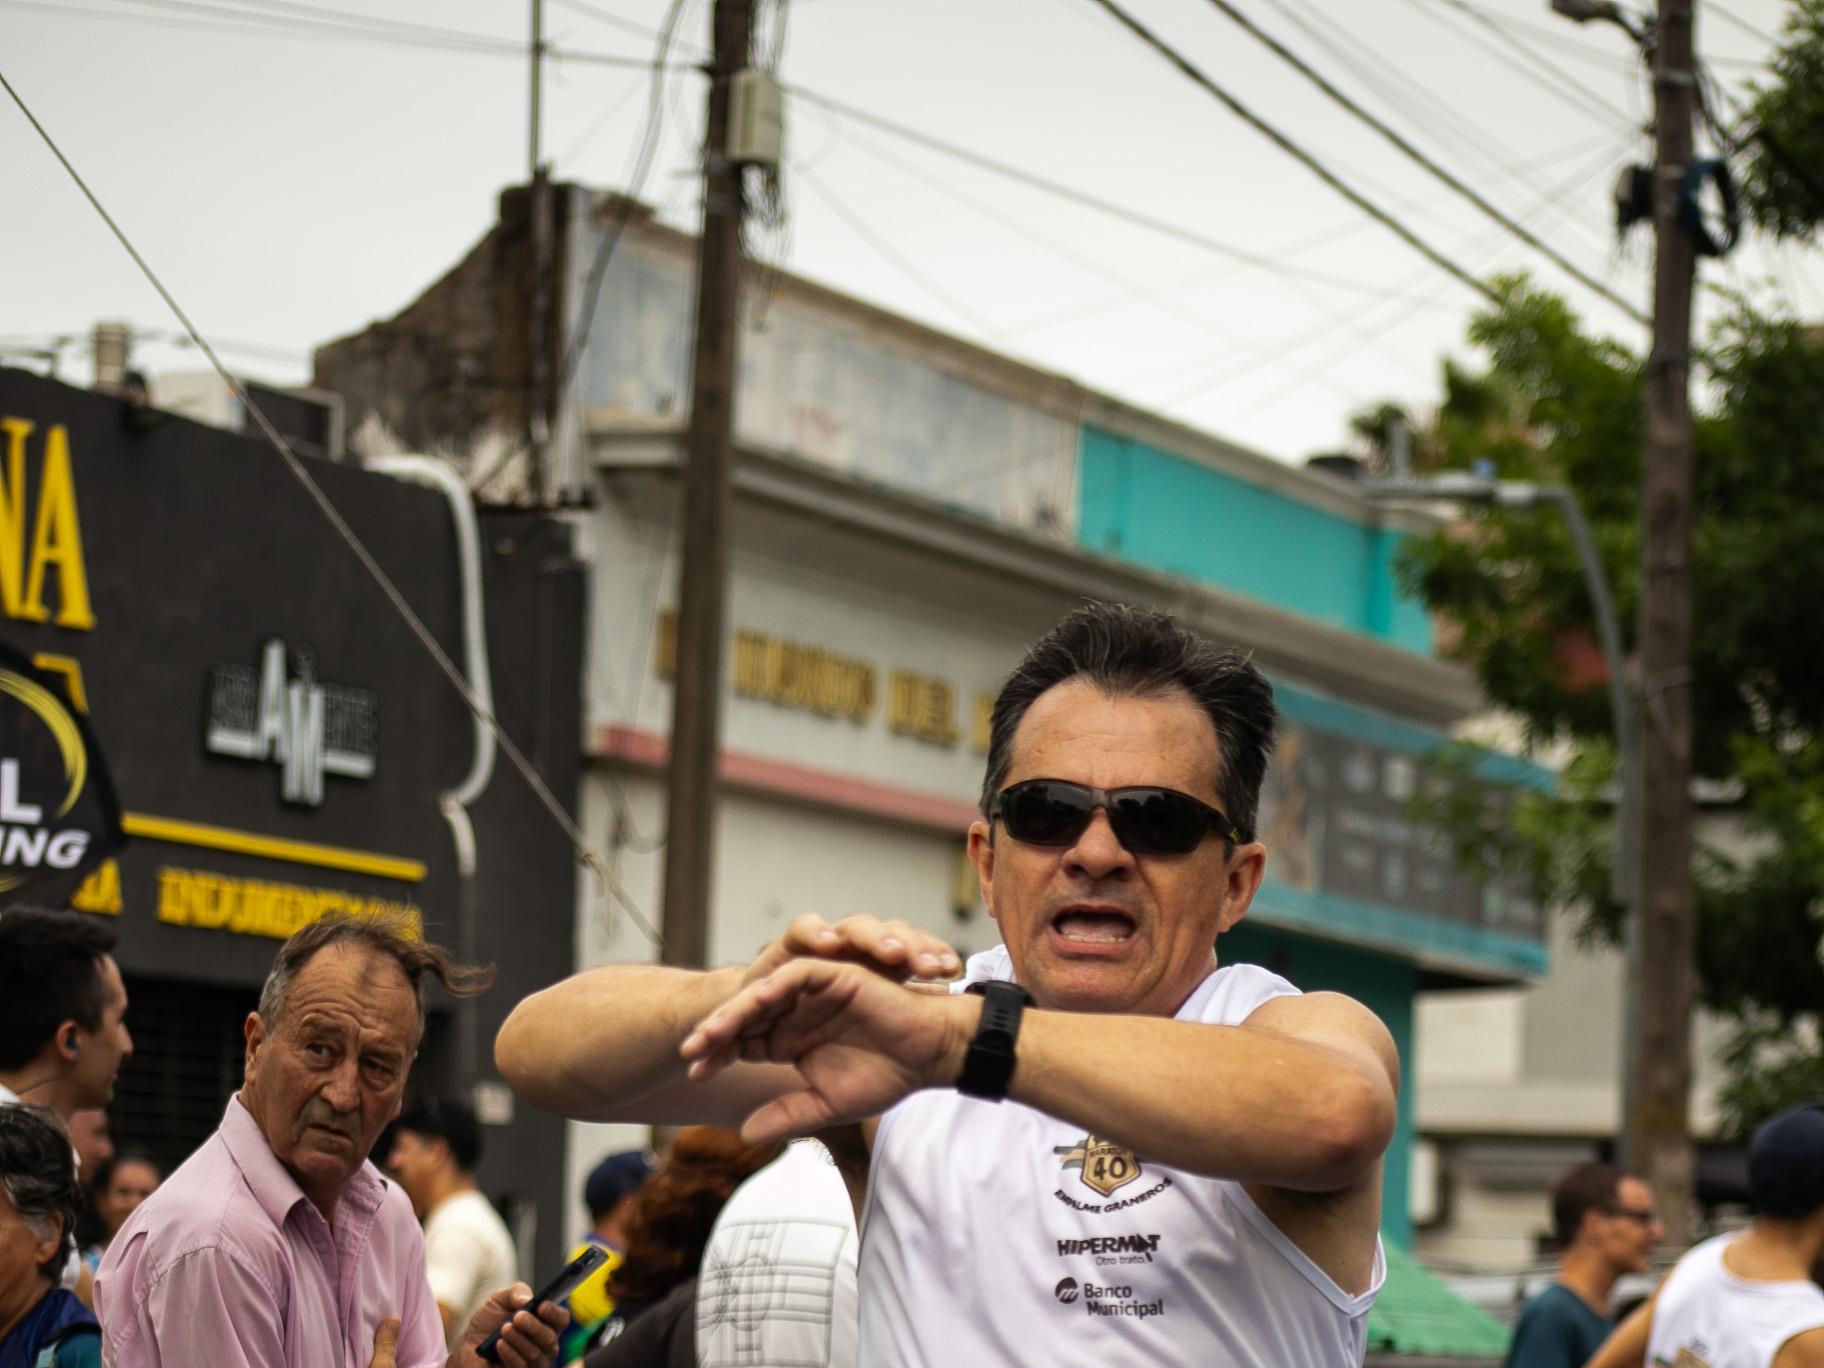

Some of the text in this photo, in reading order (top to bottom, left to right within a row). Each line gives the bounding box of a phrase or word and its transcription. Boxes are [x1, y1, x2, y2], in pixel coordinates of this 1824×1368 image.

[1093, 1156, 1128, 1181] 40
[1103, 1176, 1172, 1213] GRANEROS
[1084, 1283, 1132, 1299] Banco
[1086, 1299, 1164, 1320] Municipal
